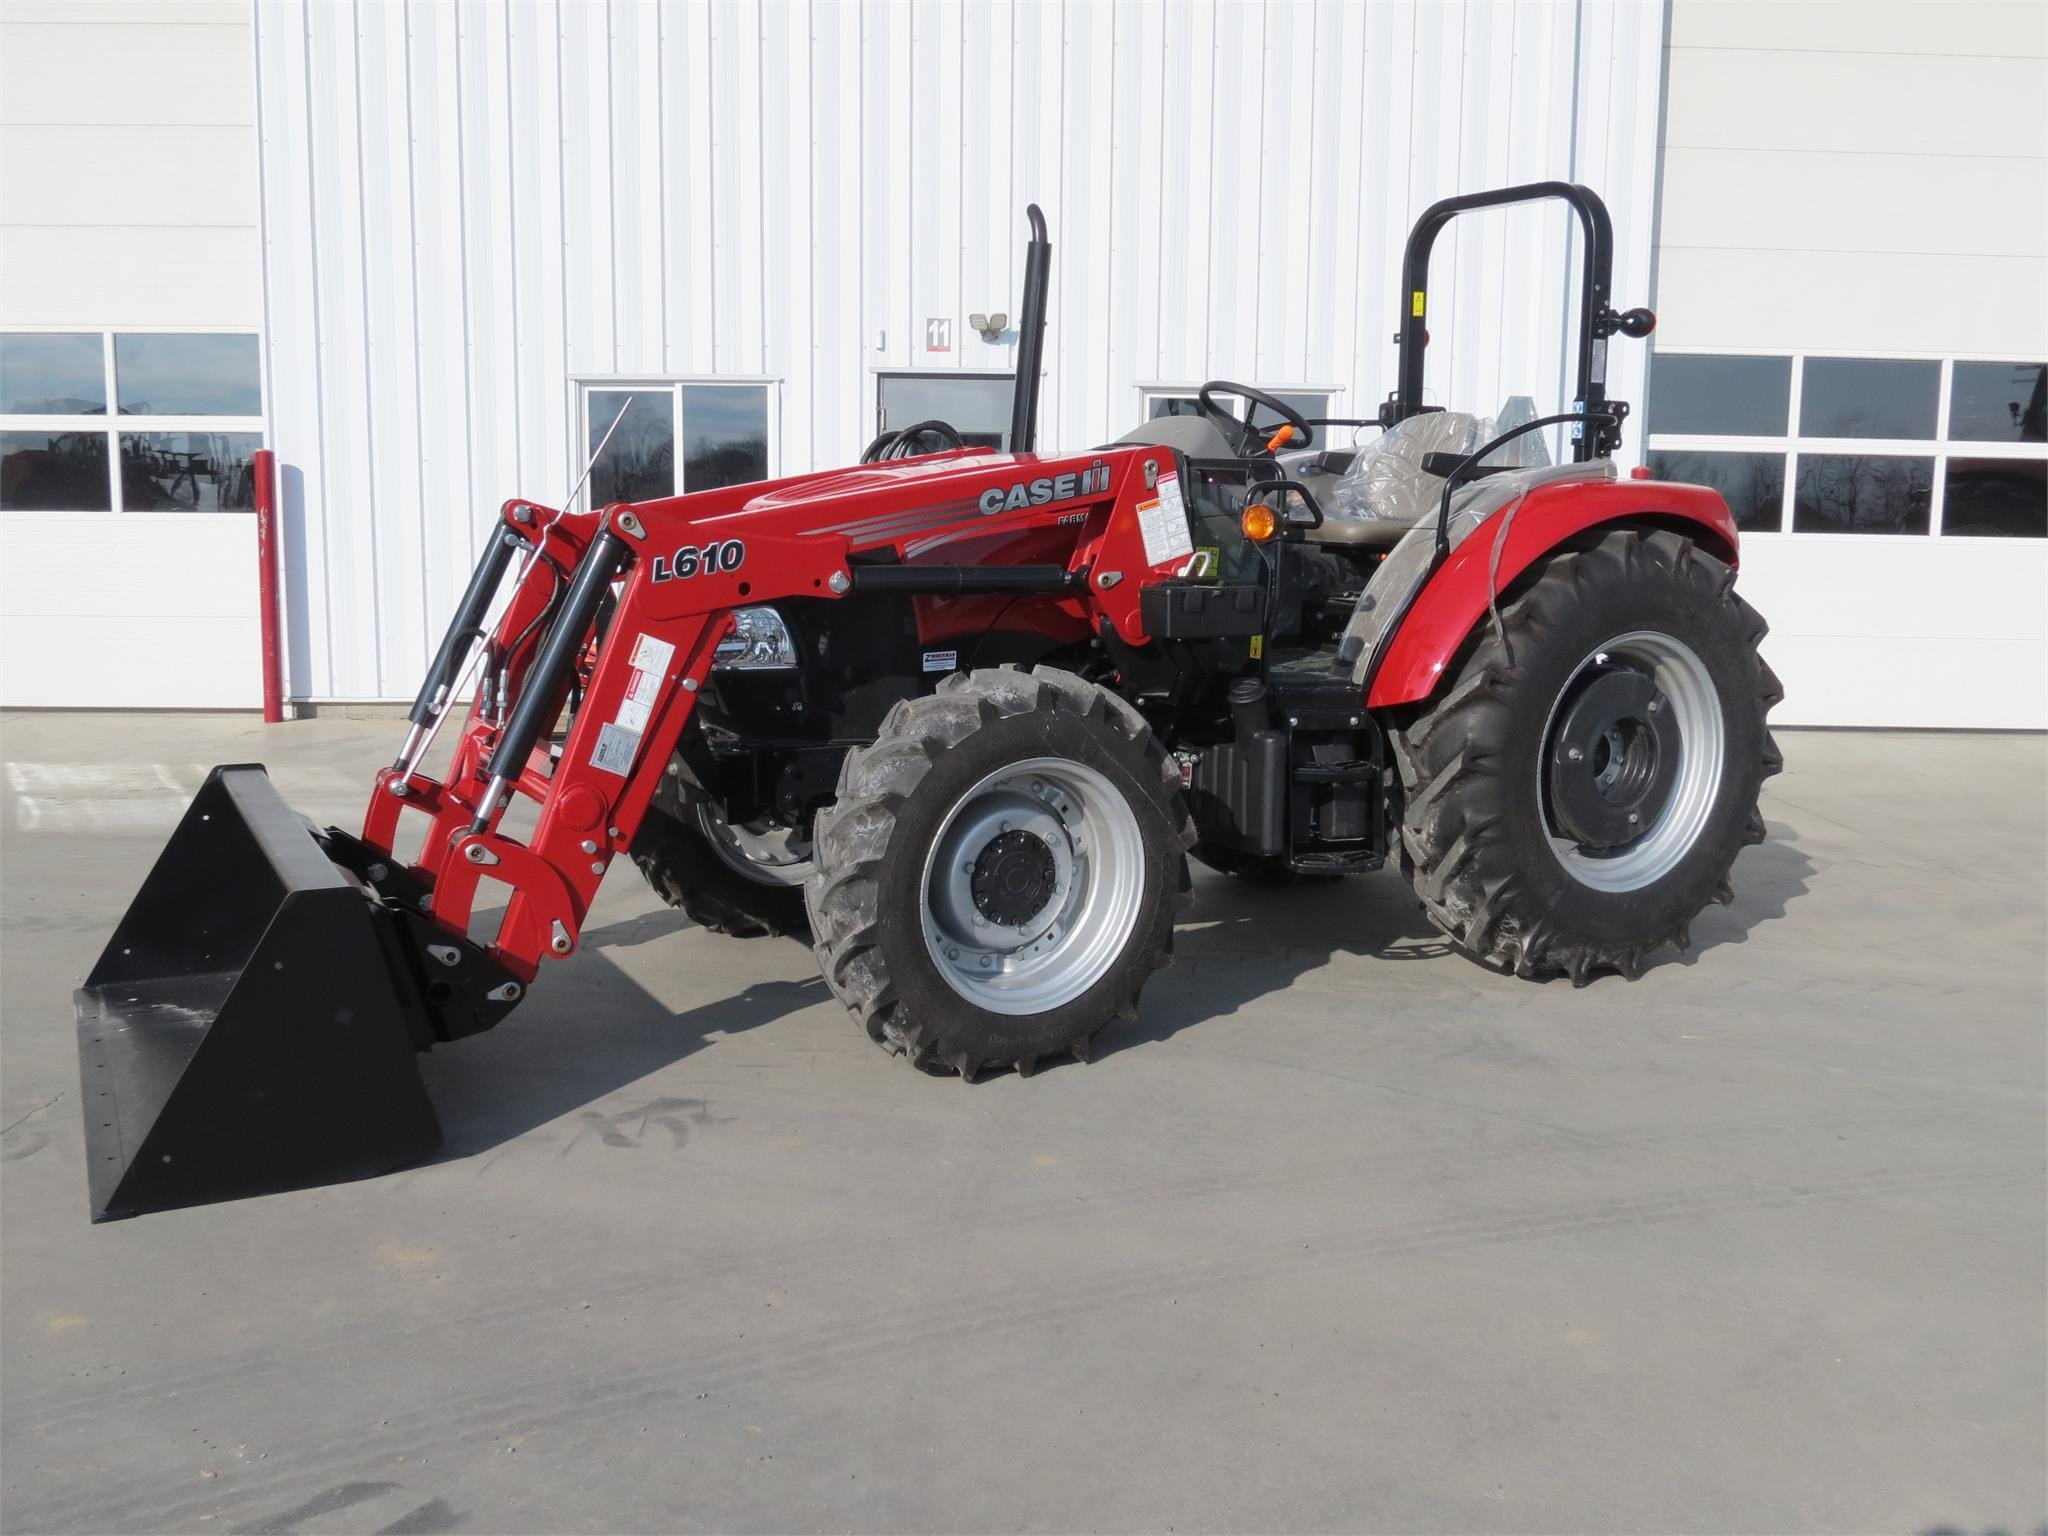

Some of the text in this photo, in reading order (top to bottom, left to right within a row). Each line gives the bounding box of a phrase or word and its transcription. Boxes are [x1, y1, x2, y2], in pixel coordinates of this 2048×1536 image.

[928, 319, 950, 347] 11
[979, 472, 1077, 515] CASE
[652, 539, 745, 584] L610
